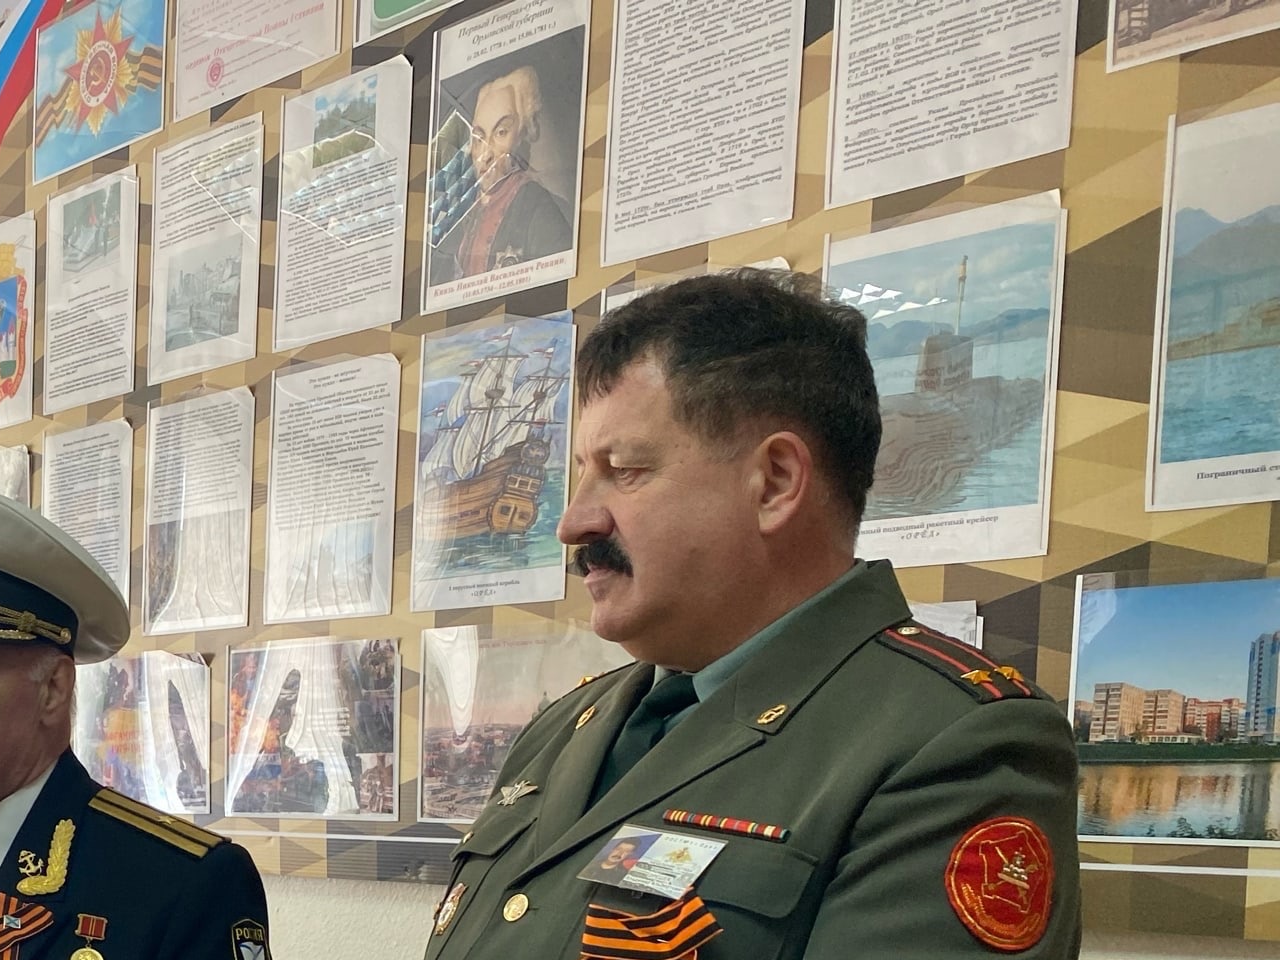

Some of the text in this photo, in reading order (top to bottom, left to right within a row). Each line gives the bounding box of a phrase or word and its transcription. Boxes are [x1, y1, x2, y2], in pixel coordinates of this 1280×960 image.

[433, 285, 455, 298] Князь
[456, 276, 488, 291] Николай
[490, 266, 534, 284] Васильевич
[1196, 465, 1267, 480] Пограничный
[882, 522, 925, 534] подводный
[926, 518, 964, 530] ракетный
[966, 515, 999, 524] крейсер
